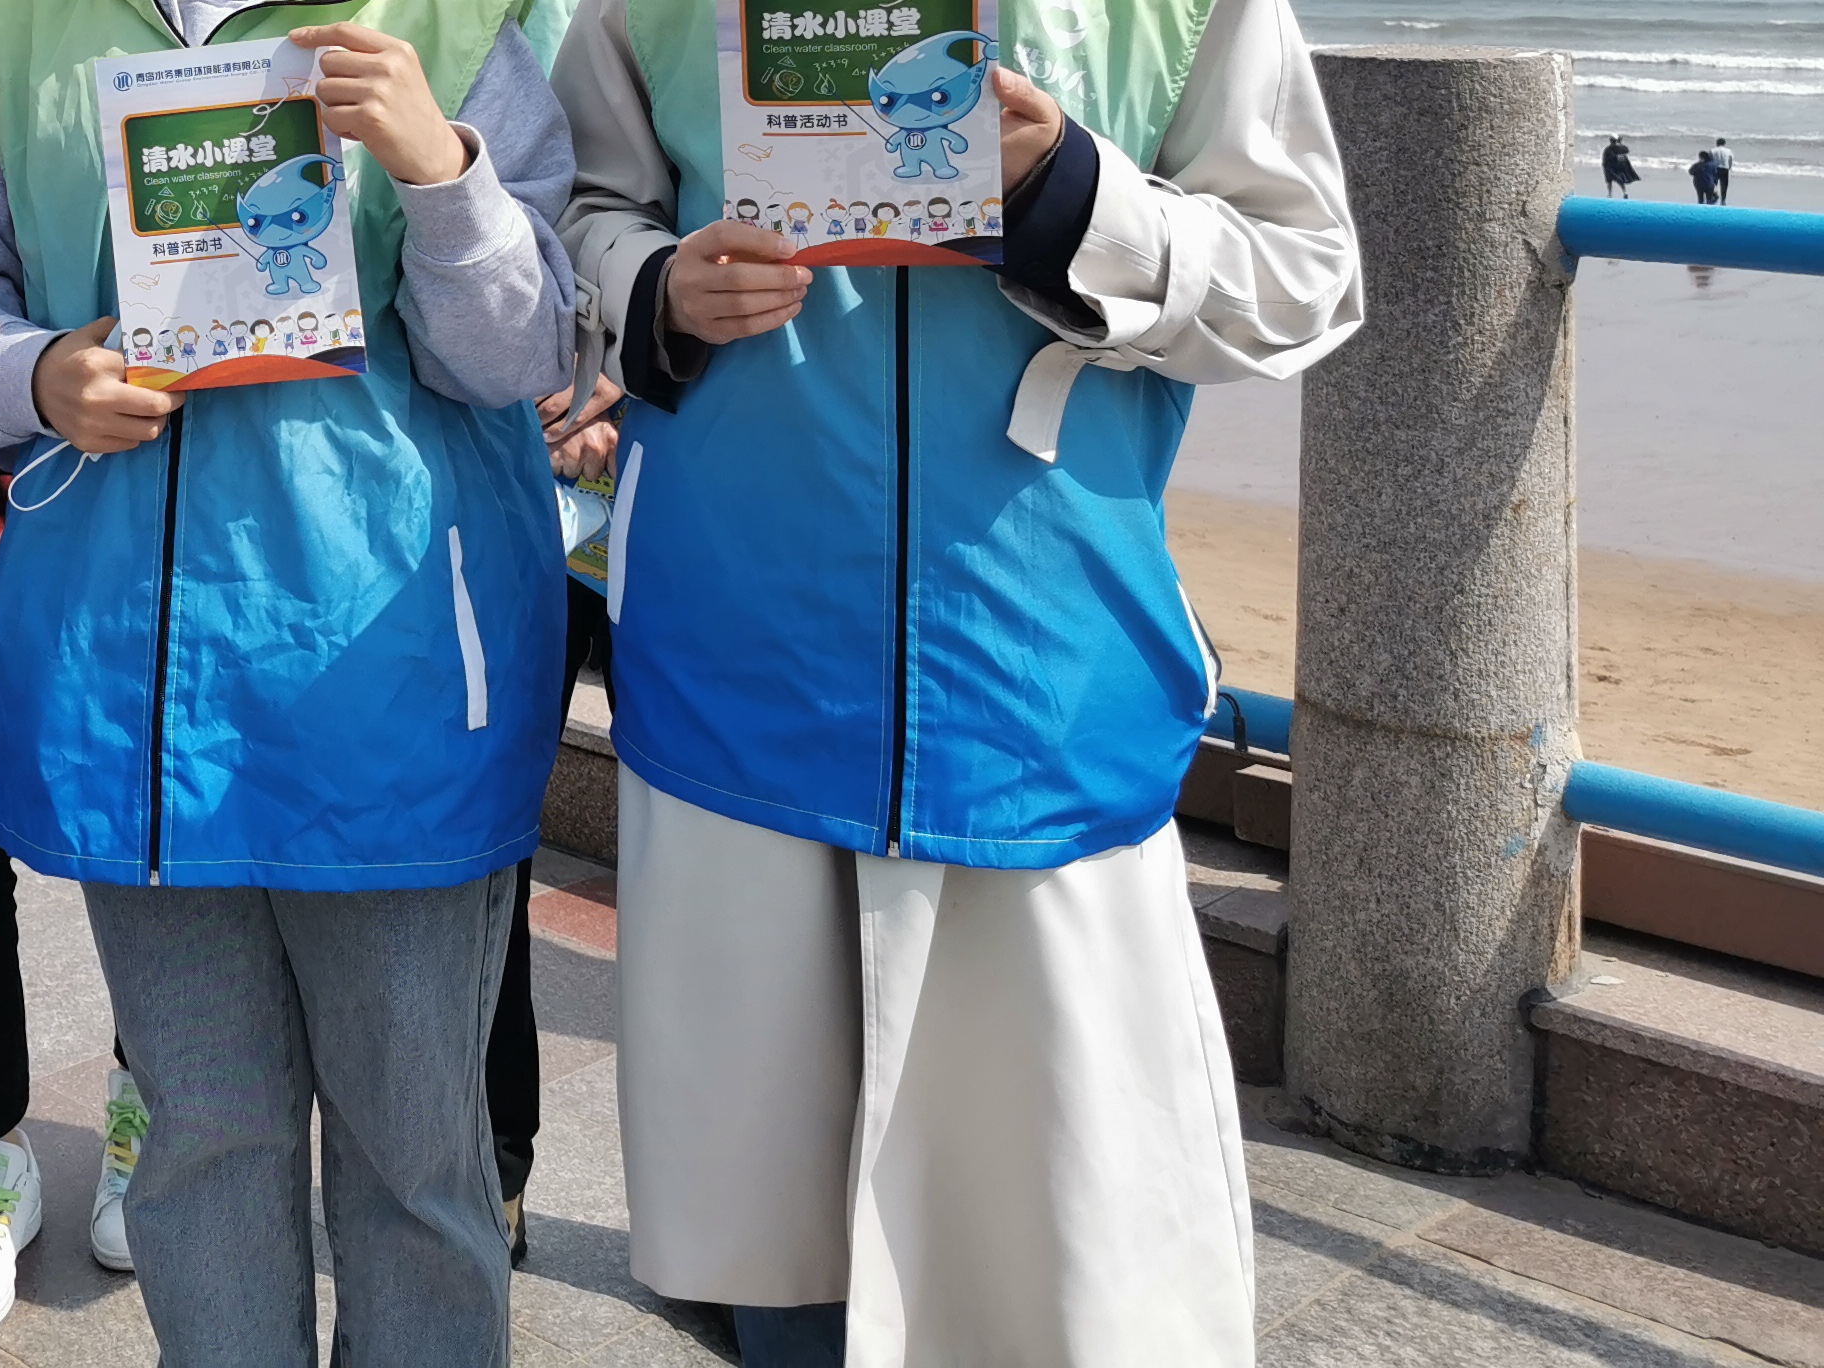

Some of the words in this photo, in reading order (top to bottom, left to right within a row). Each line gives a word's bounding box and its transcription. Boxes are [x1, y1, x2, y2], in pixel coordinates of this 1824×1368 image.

[761, 7, 921, 40] 清水小课堂
[762, 44, 792, 54] Clean
[793, 45, 823, 53] water
[824, 42, 878, 53] classroom
[136, 58, 272, 83] 青岛水务集团环境能源有限公司
[766, 113, 848, 130] 科普活动书
[142, 135, 277, 173] 清水小课堂
[144, 177, 170, 186] Clean
[171, 173, 195, 183] water
[197, 169, 242, 181] classroom
[152, 236, 223, 257] 科普活动书
